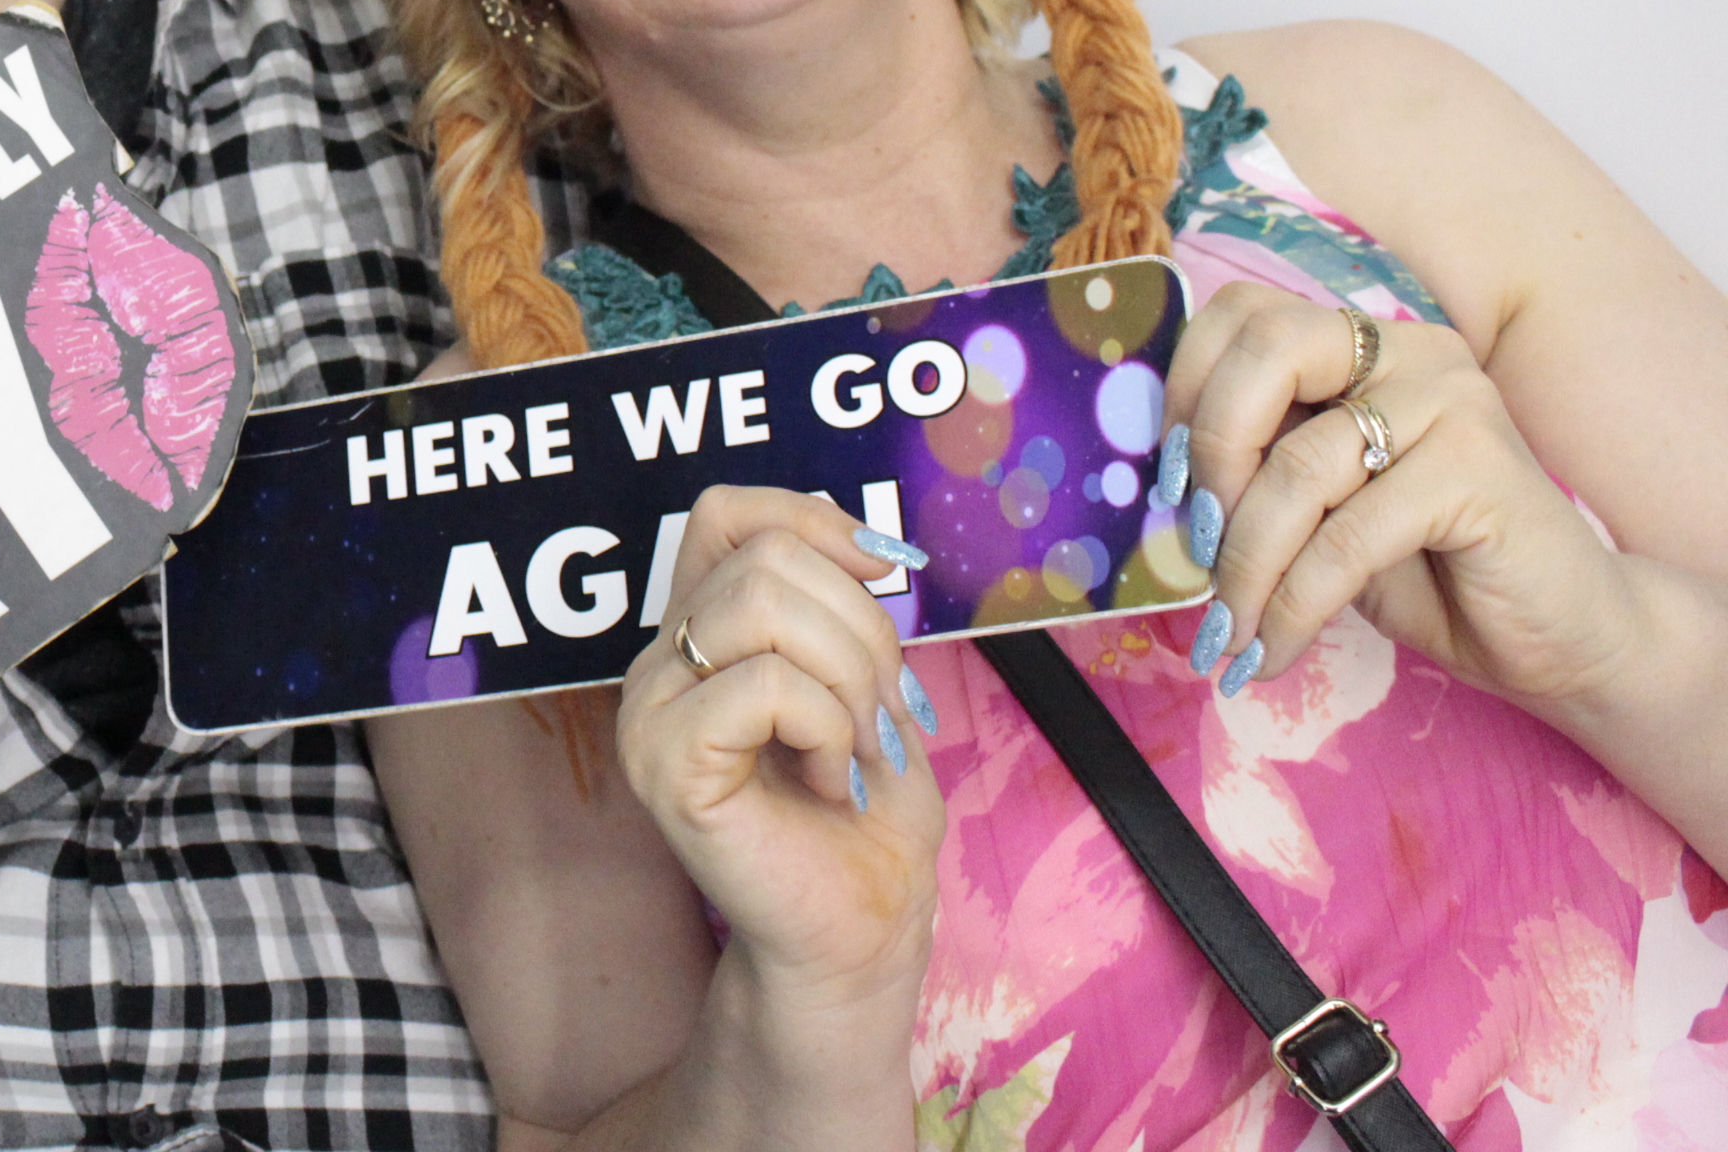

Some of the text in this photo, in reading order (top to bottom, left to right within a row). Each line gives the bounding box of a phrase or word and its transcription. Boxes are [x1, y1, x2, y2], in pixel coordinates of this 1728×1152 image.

[346, 339, 966, 506] HERE WE GO
